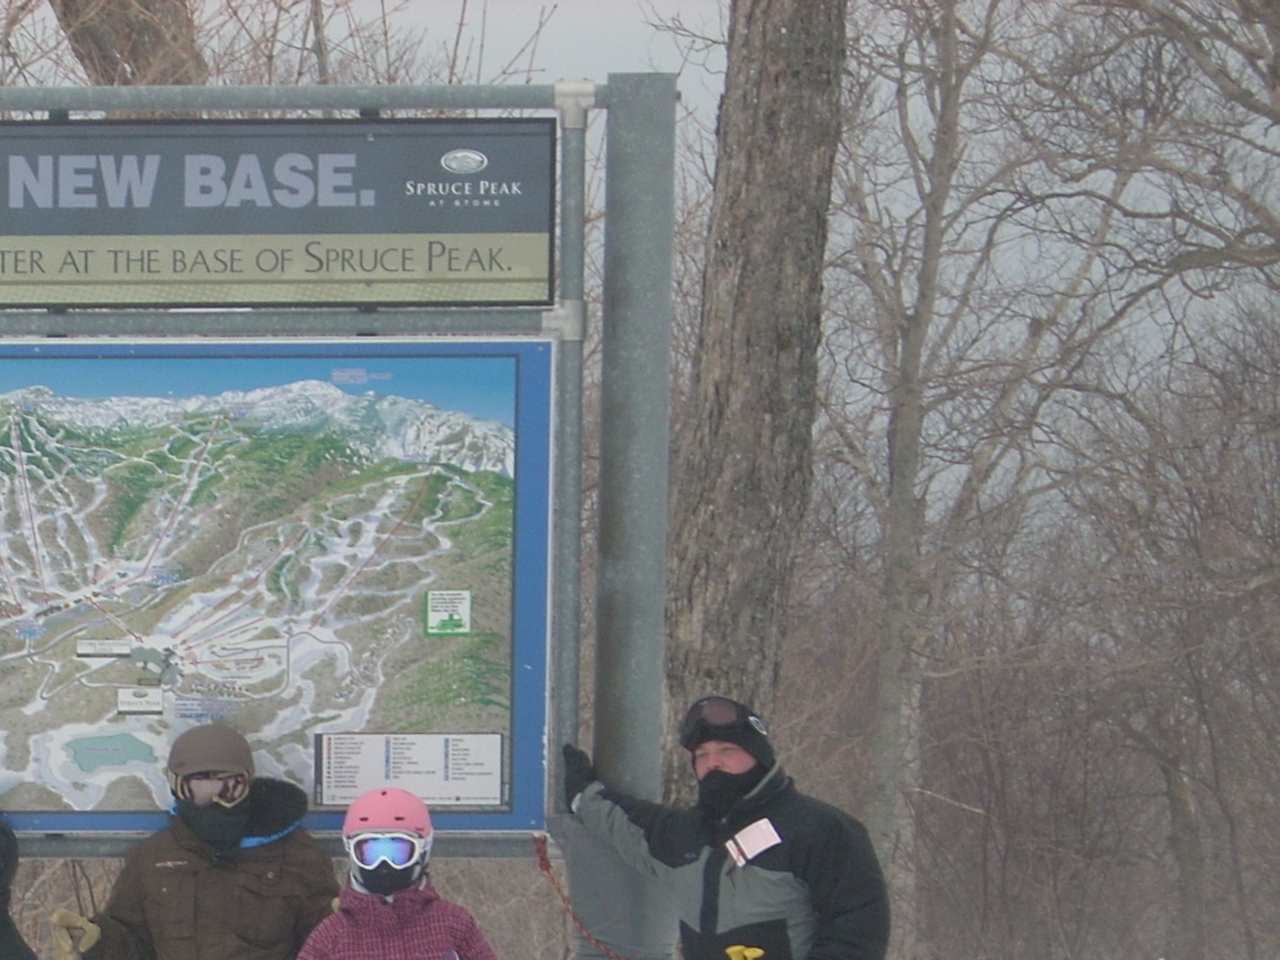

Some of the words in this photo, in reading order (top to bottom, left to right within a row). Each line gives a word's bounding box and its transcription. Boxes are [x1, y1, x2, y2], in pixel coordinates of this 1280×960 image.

[8, 154, 160, 209] NEW
[184, 152, 376, 209] BASE.
[405, 180, 472, 195] SPRUCE
[479, 180, 522, 195] PEAK
[58, 249, 95, 274] AT
[106, 249, 161, 274] THE
[172, 248, 244, 274] BASE
[255, 248, 294, 273] OF
[304, 241, 416, 273] SPRUCE
[426, 240, 513, 273] PEAK.
